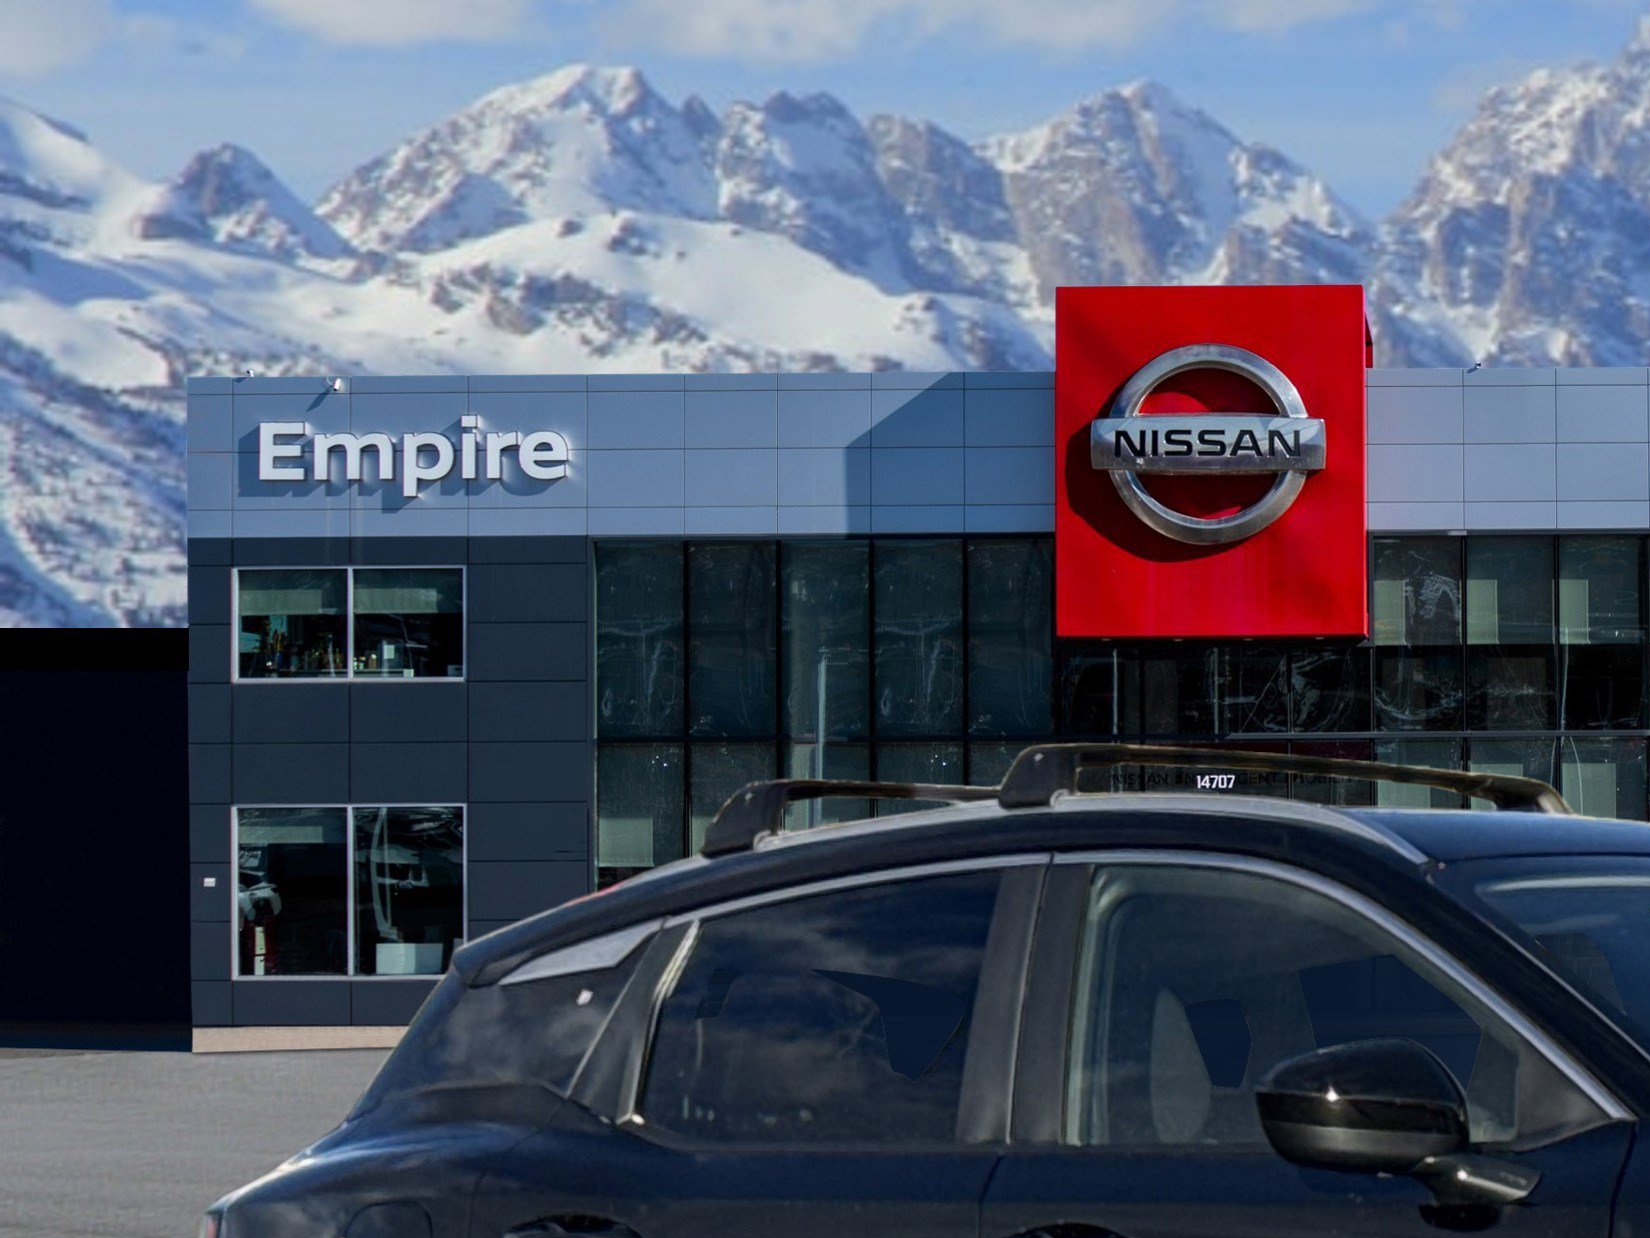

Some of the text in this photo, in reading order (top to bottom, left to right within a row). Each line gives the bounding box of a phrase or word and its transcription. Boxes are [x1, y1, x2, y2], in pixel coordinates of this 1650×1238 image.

[258, 414, 570, 498] Empire
[1114, 429, 1300, 458] NISSAN
[1196, 774, 1236, 789] 14707
